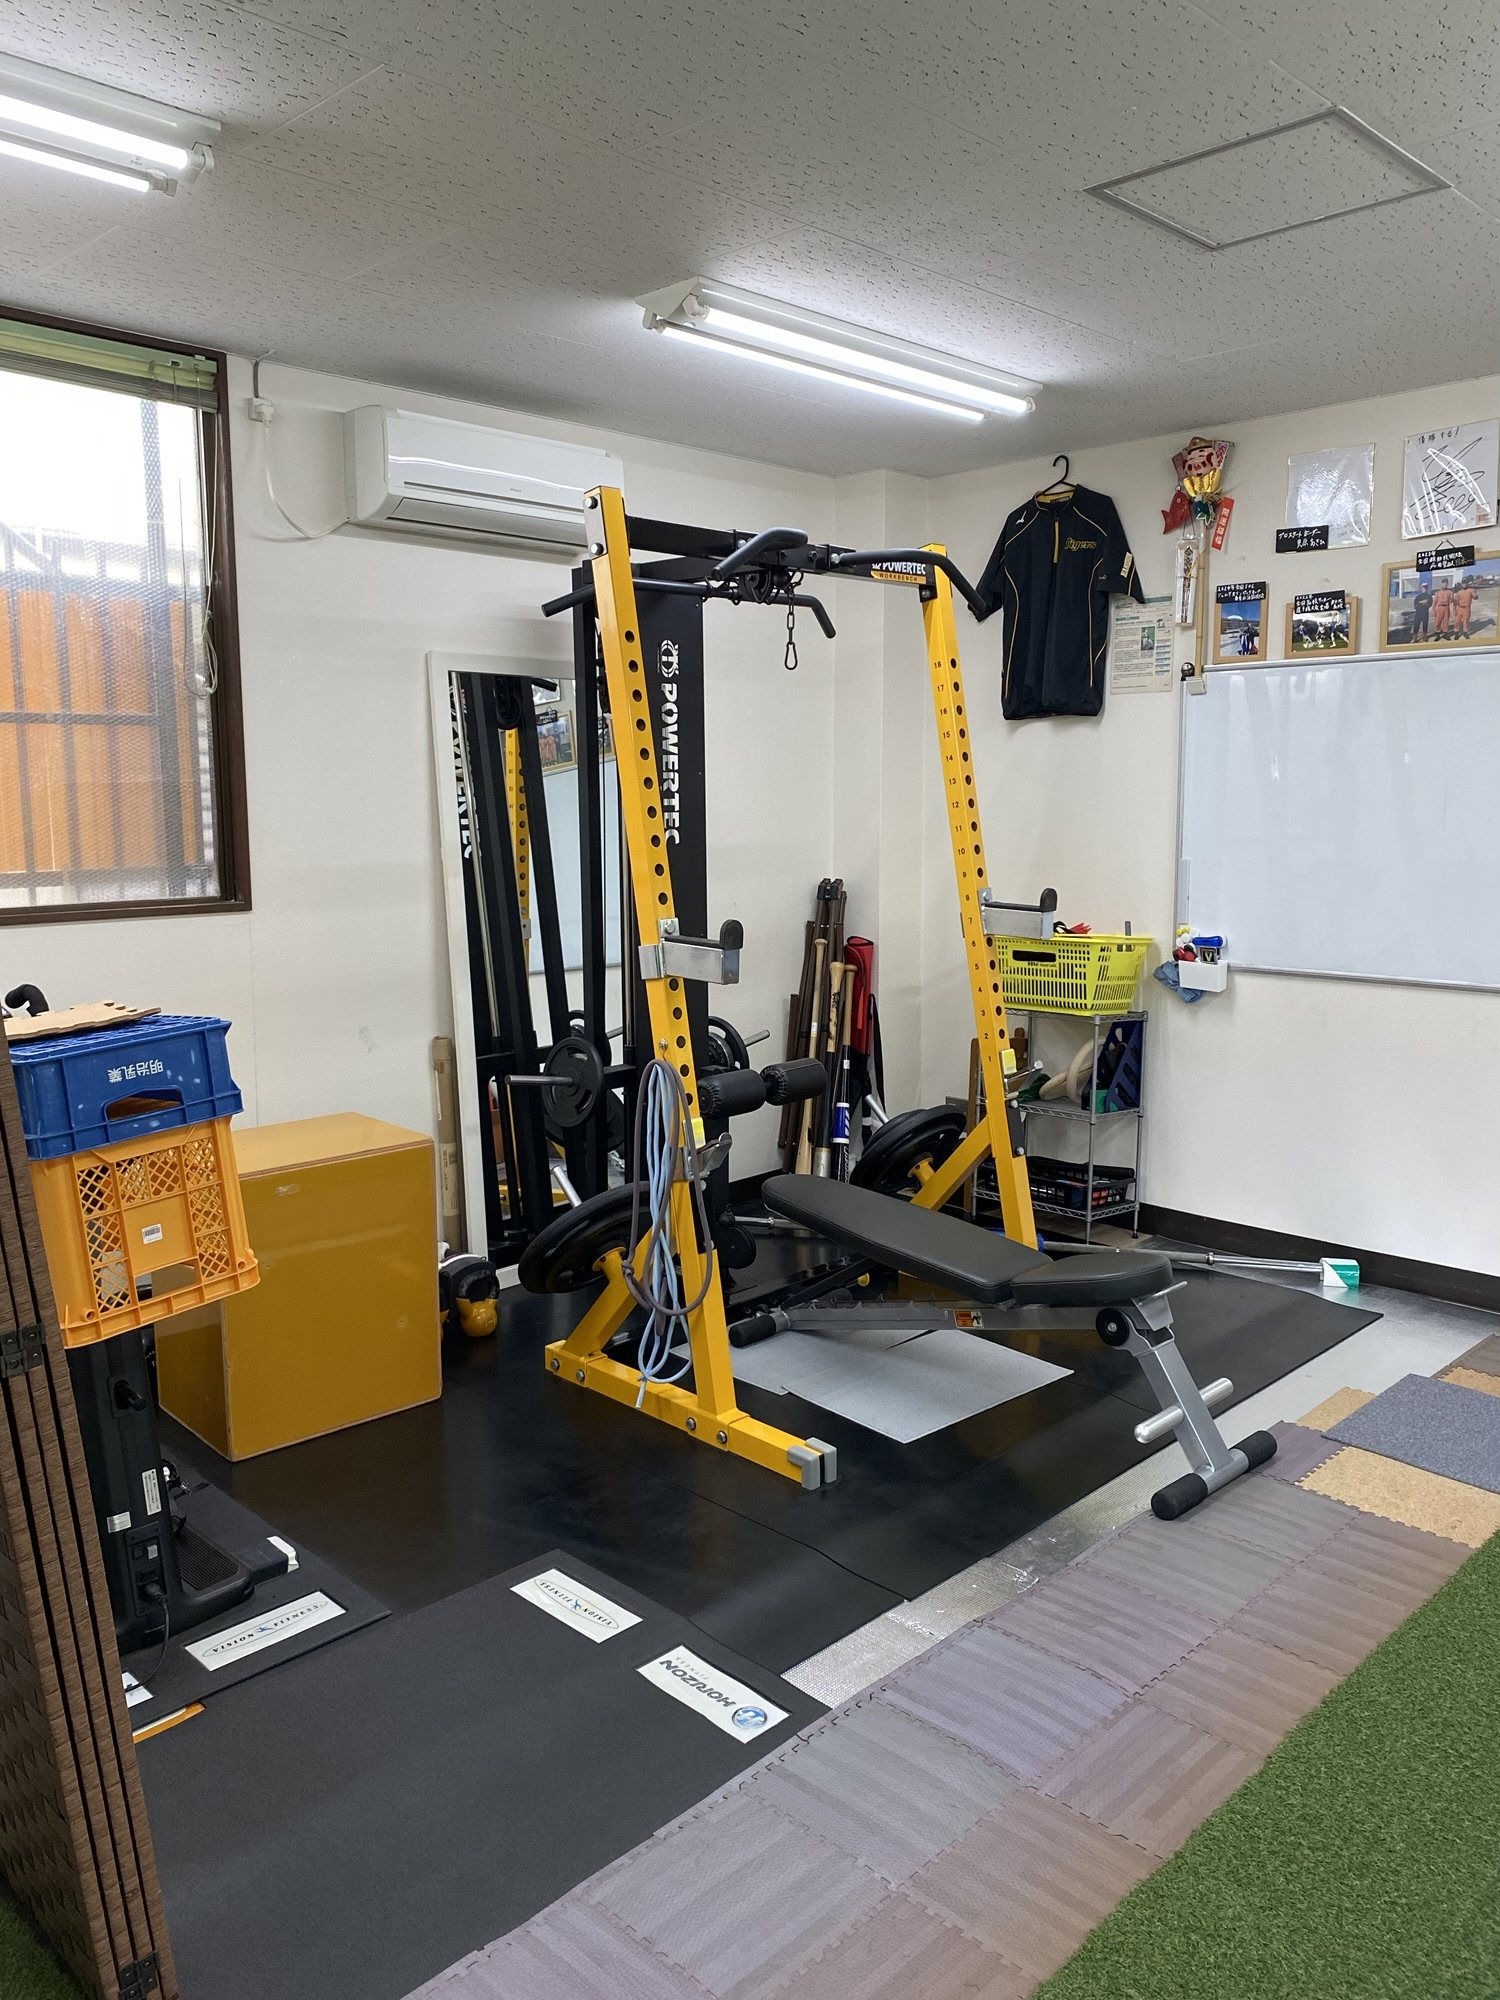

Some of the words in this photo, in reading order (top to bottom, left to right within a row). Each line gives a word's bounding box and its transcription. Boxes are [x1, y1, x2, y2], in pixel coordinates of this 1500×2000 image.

[882, 562, 926, 574] POWERTEC
[879, 572, 918, 582] WORKBENCH
[934, 660, 942, 669] 18
[936, 683, 944, 693] 17
[940, 707, 948, 716] 16
[942, 730, 950, 740] 15
[660, 682, 680, 845] POWERTEC
[946, 754, 954, 763] 14
[948, 777, 956, 786] 13
[952, 800, 960, 809] 12
[956, 824, 962, 833] 11
[958, 847, 966, 856] 10
[968, 916, 973, 925] 7
[974, 962, 980, 971] 5
[108, 1059, 164, 1083] 明治乳業
[540, 1581, 573, 1604] FITNESS
[582, 1607, 612, 1626] VISION
[212, 1632, 254, 1653] VISION
[274, 1604, 319, 1627] FITNESS
[676, 1656, 708, 1680] FITNESS
[658, 1660, 736, 1708] HORIZON
